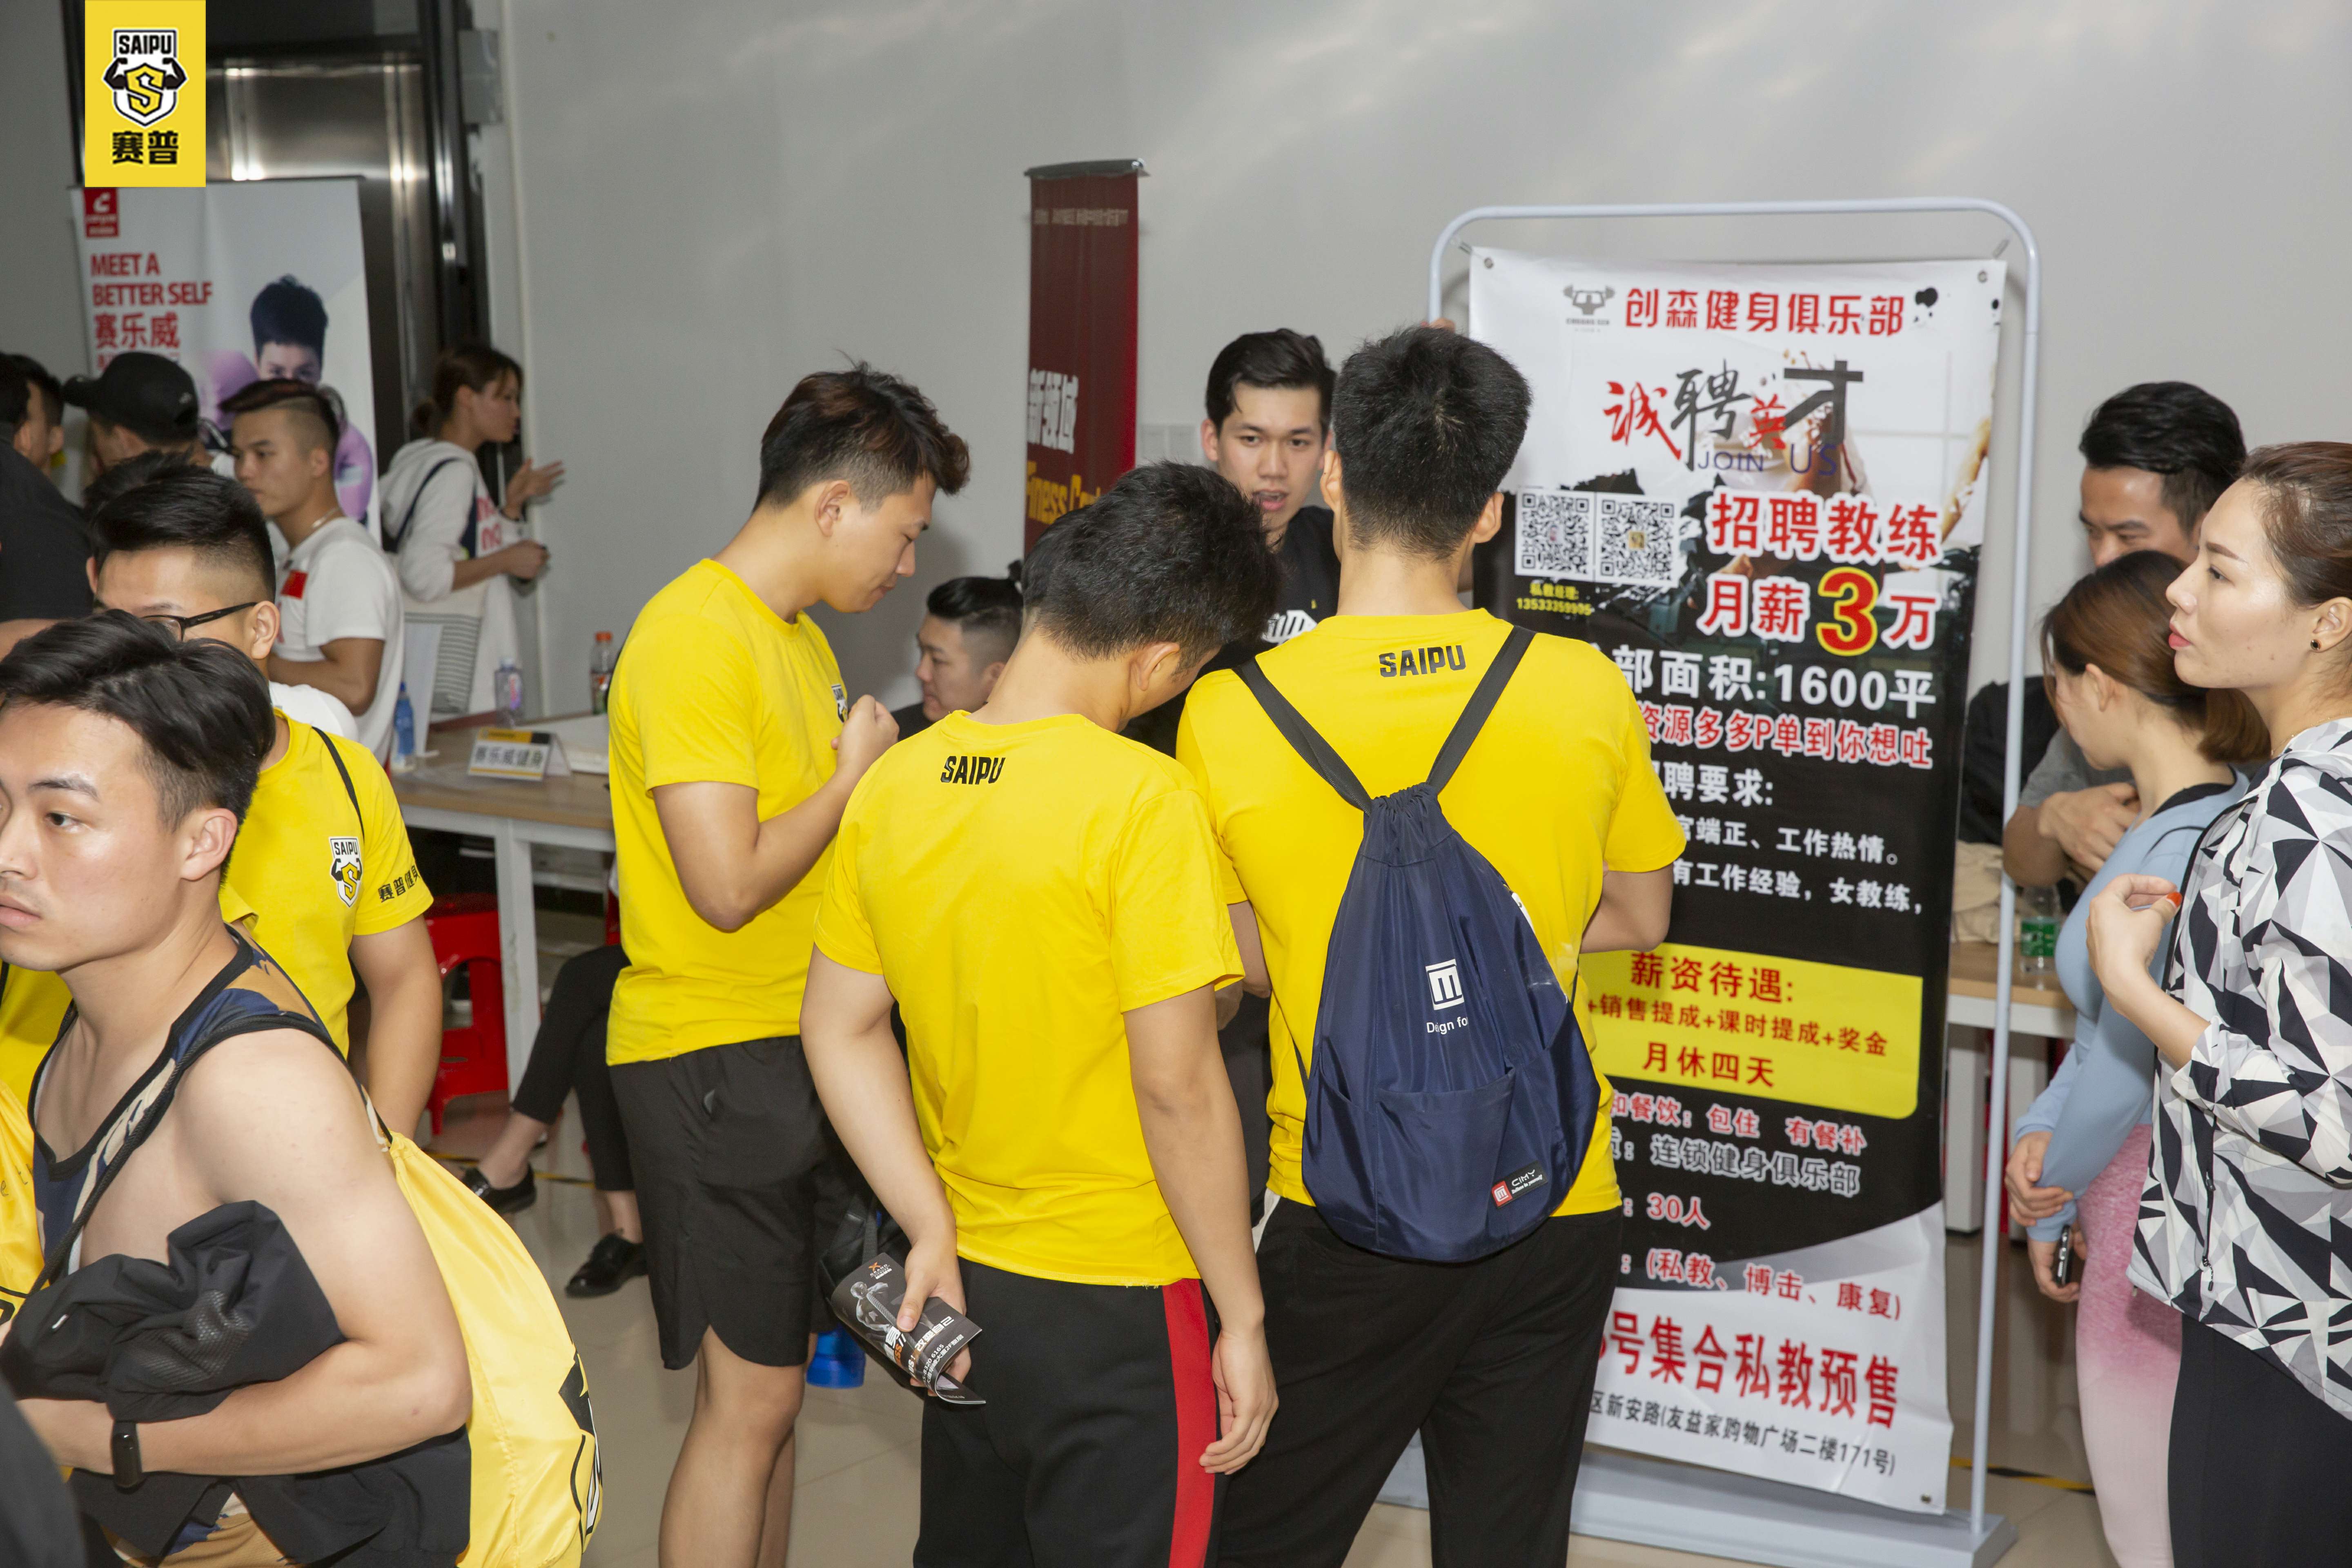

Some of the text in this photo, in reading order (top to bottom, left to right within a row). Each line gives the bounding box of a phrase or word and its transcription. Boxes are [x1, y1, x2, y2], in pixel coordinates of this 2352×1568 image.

[91, 252, 160, 276] MEET A
[93, 281, 213, 306] BETTER SELF
[1625, 287, 1906, 338] 创森健身俱乐部
[94, 311, 180, 349] 赛乐威
[1698, 443, 1838, 476] JOIN US
[1709, 490, 1942, 565] 招聘教练
[1699, 567, 1941, 656] 月薪3万
[1379, 645, 1466, 678] SAIPU
[1590, 643, 1937, 719] 部面积:1600平
[940, 756, 1006, 785] SAIPU
[1653, 760, 1773, 807] 聘要求:
[334, 841, 358, 855] SAIPU
[1631, 951, 1793, 1002] 薪资待遇:
[1642, 1041, 1774, 1087] 月休四天
[1512, 1169, 1535, 1186] CIMY
[931, 1344, 944, 1358] 6165
[1598, 1310, 1899, 1429] 号集合私教预售
